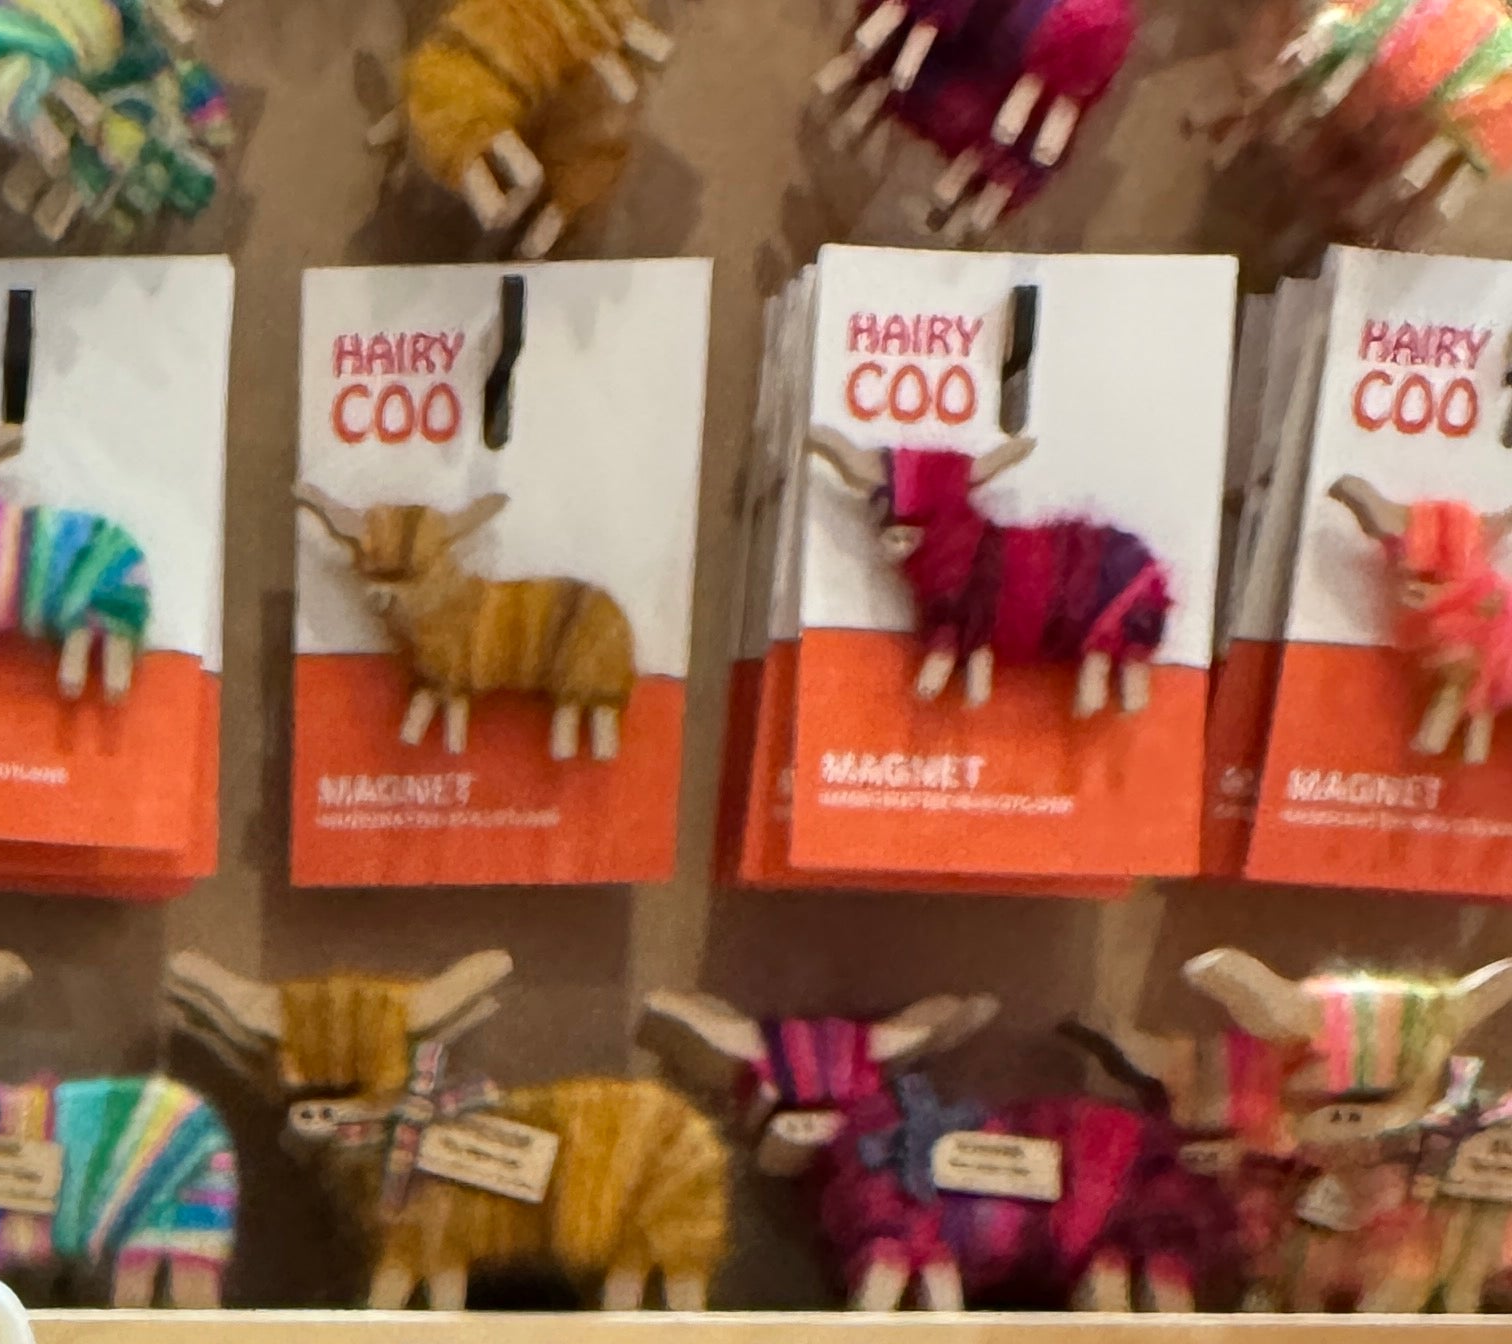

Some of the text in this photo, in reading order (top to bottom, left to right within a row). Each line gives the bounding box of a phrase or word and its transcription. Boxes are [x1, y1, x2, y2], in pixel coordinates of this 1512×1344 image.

[333, 331, 464, 377] HAIRY
[849, 312, 984, 357] HAIRY
[1359, 319, 1492, 369] HAIRY
[331, 383, 461, 444] COO
[845, 361, 976, 425] COO
[1352, 370, 1478, 437] COO
[820, 752, 986, 791] MAGNET
